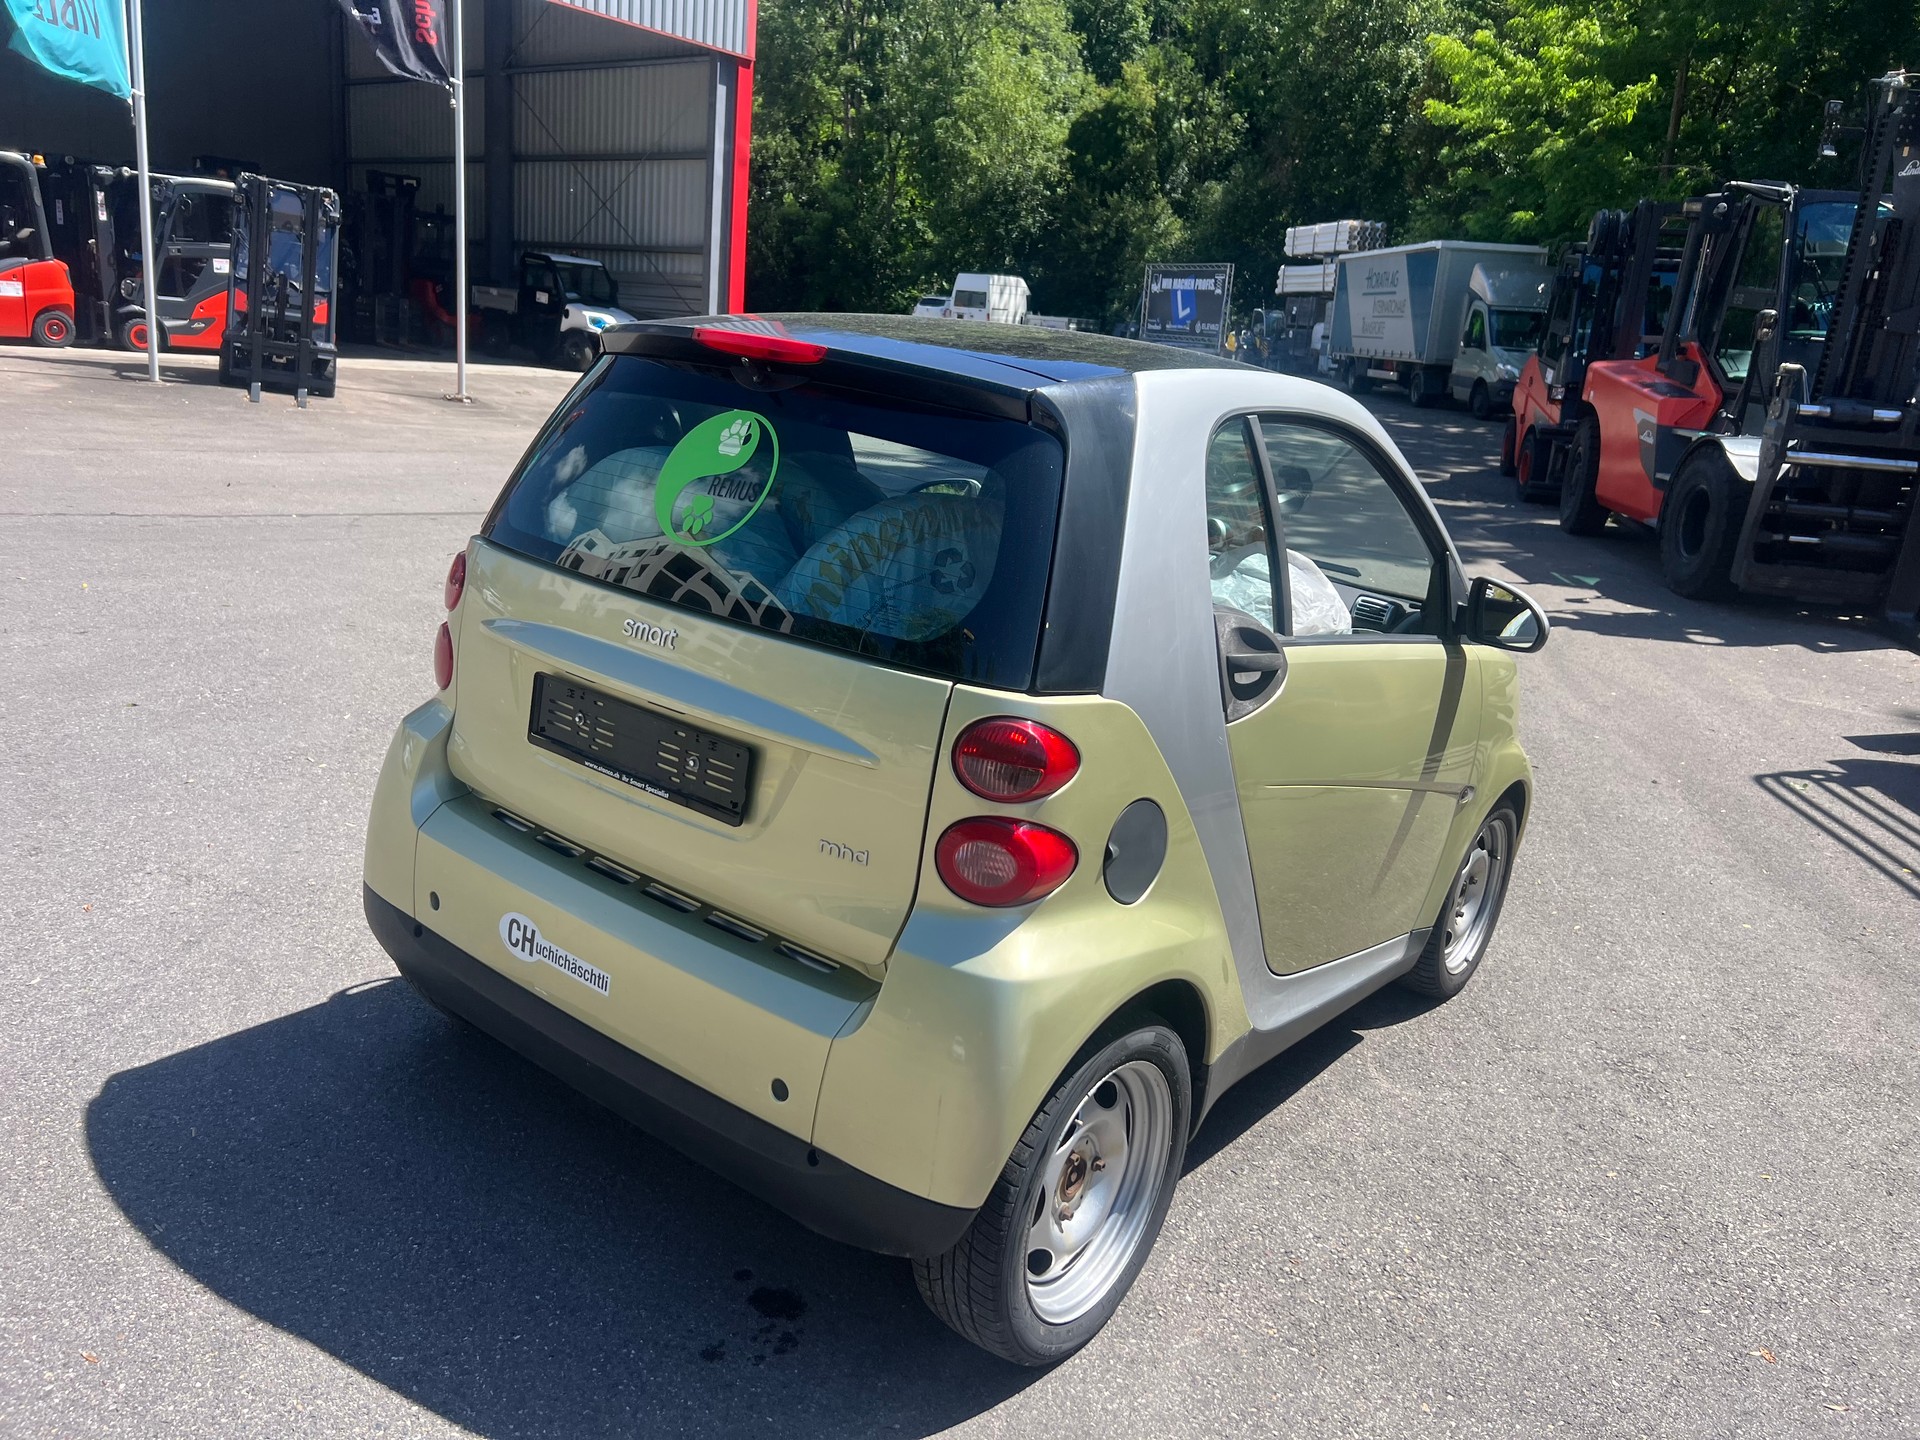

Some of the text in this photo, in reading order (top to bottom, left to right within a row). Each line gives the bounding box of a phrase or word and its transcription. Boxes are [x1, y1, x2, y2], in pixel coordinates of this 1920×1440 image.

[1173, 278, 1195, 290] MACHEN
[707, 476, 760, 502] REMUS
[622, 618, 679, 650] smart
[629, 777, 645, 789] Smart
[645, 783, 669, 798] Spezialist
[819, 838, 869, 866] mhd
